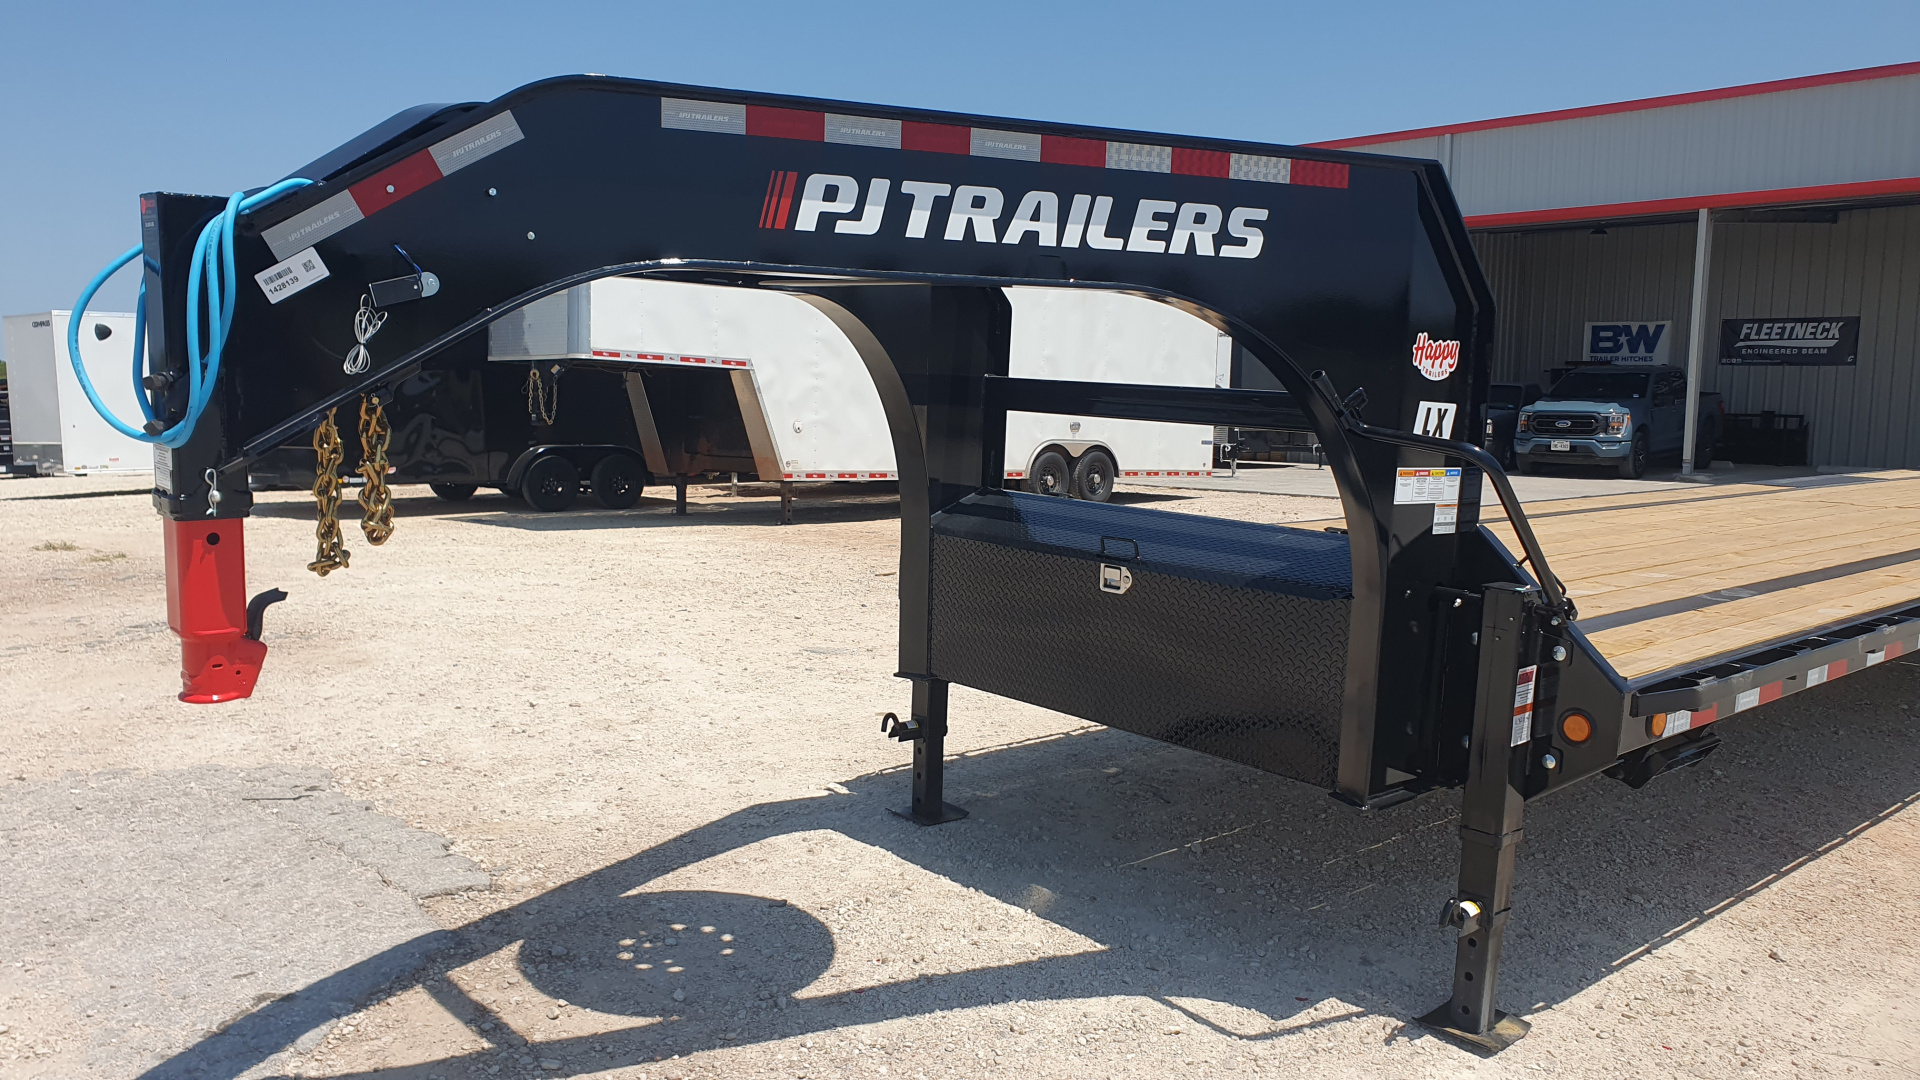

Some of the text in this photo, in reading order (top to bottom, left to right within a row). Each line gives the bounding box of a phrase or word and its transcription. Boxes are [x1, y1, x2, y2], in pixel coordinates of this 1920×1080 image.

[691, 113, 729, 122] TRAILERS
[465, 129, 501, 152] TRAILERS
[851, 128, 886, 137] TRAILERS
[995, 142, 1027, 150] TRAILERS
[301, 211, 340, 237] TRAILERS
[795, 173, 1269, 259] PJ TRAILERS
[268, 276, 299, 295] 1428139
[1740, 322, 1844, 339] FLEETNECK
[1414, 334, 1459, 369] Happy
[1422, 365, 1448, 378] TRAILERS
[1421, 406, 1449, 438] LX
